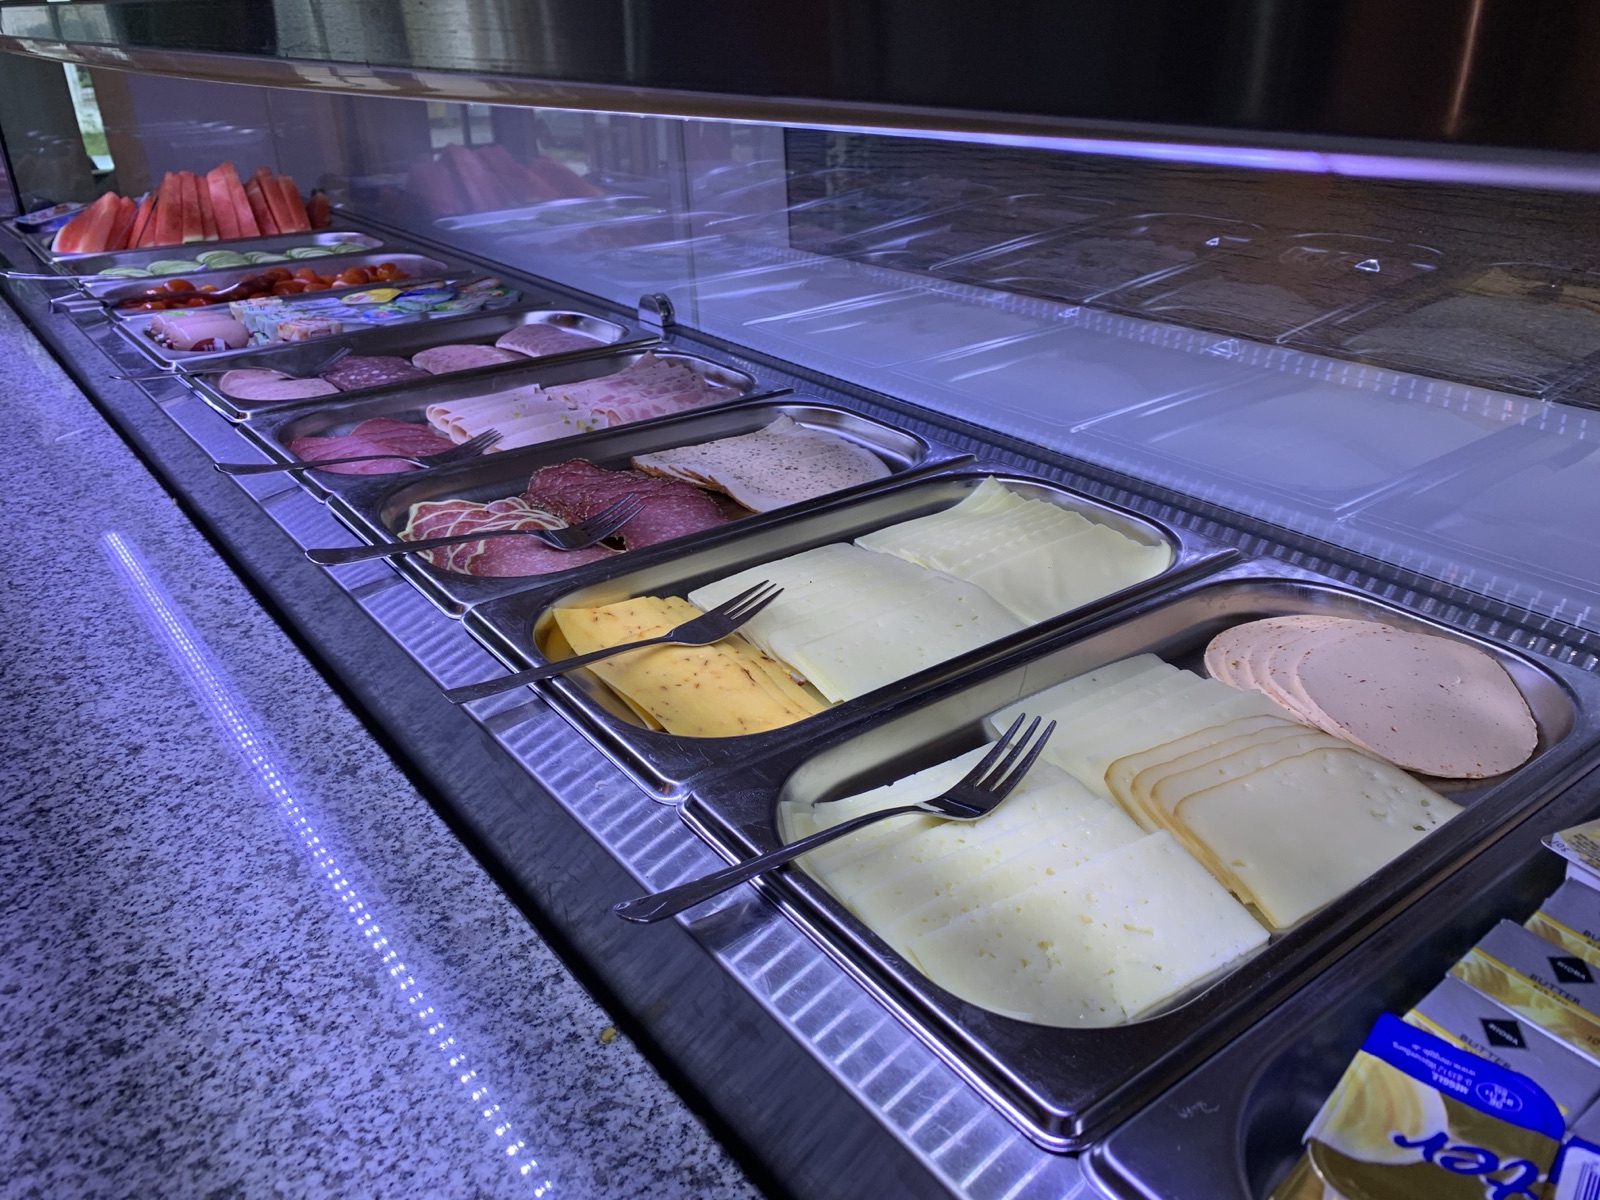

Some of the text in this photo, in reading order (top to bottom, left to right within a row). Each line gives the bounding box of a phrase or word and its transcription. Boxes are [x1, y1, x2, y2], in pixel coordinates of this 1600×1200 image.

[1556, 960, 1586, 981] RIOBA
[1529, 973, 1580, 1005] BUTTER
[1488, 1022, 1519, 1046] RIOBA
[1459, 1033, 1512, 1070] BUTTER
